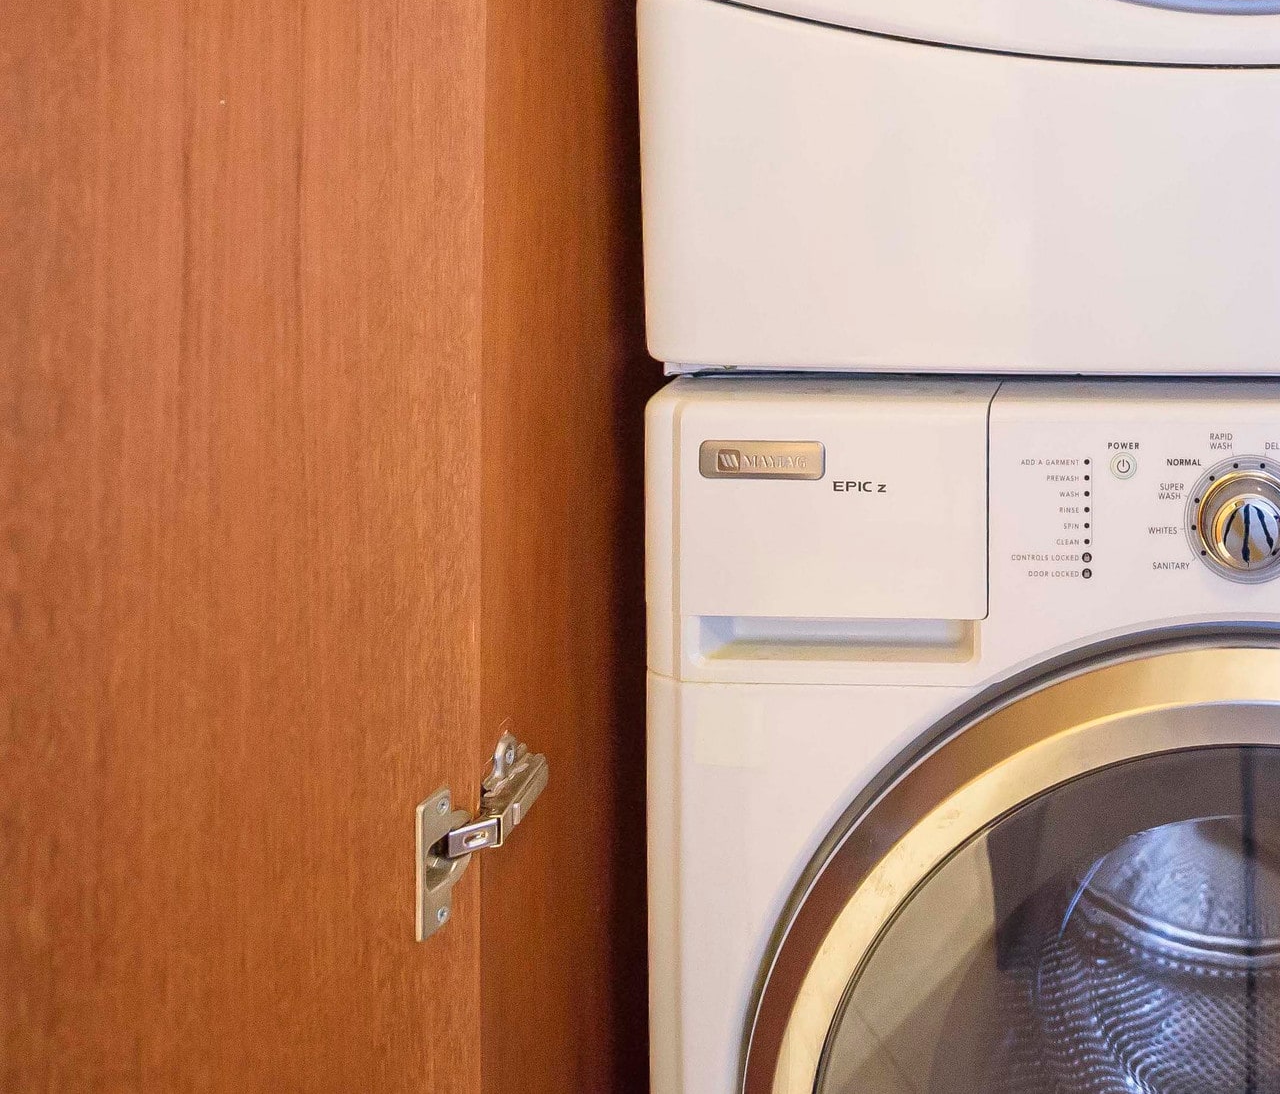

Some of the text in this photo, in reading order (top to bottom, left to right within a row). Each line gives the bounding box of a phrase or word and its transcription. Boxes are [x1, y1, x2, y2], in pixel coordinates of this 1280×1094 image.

[1209, 433, 1233, 441] RAPID
[1107, 442, 1140, 450] POWER
[1210, 442, 1233, 450] WASH
[743, 455, 807, 468] MAYTAG
[1166, 458, 1202, 466] NORMAL
[833, 481, 872, 492] EPIC
[1160, 483, 1184, 491] SUPER
[1158, 492, 1181, 500] WASH
[1148, 527, 1178, 535] WHITES
[1152, 562, 1190, 570] SANITARY
